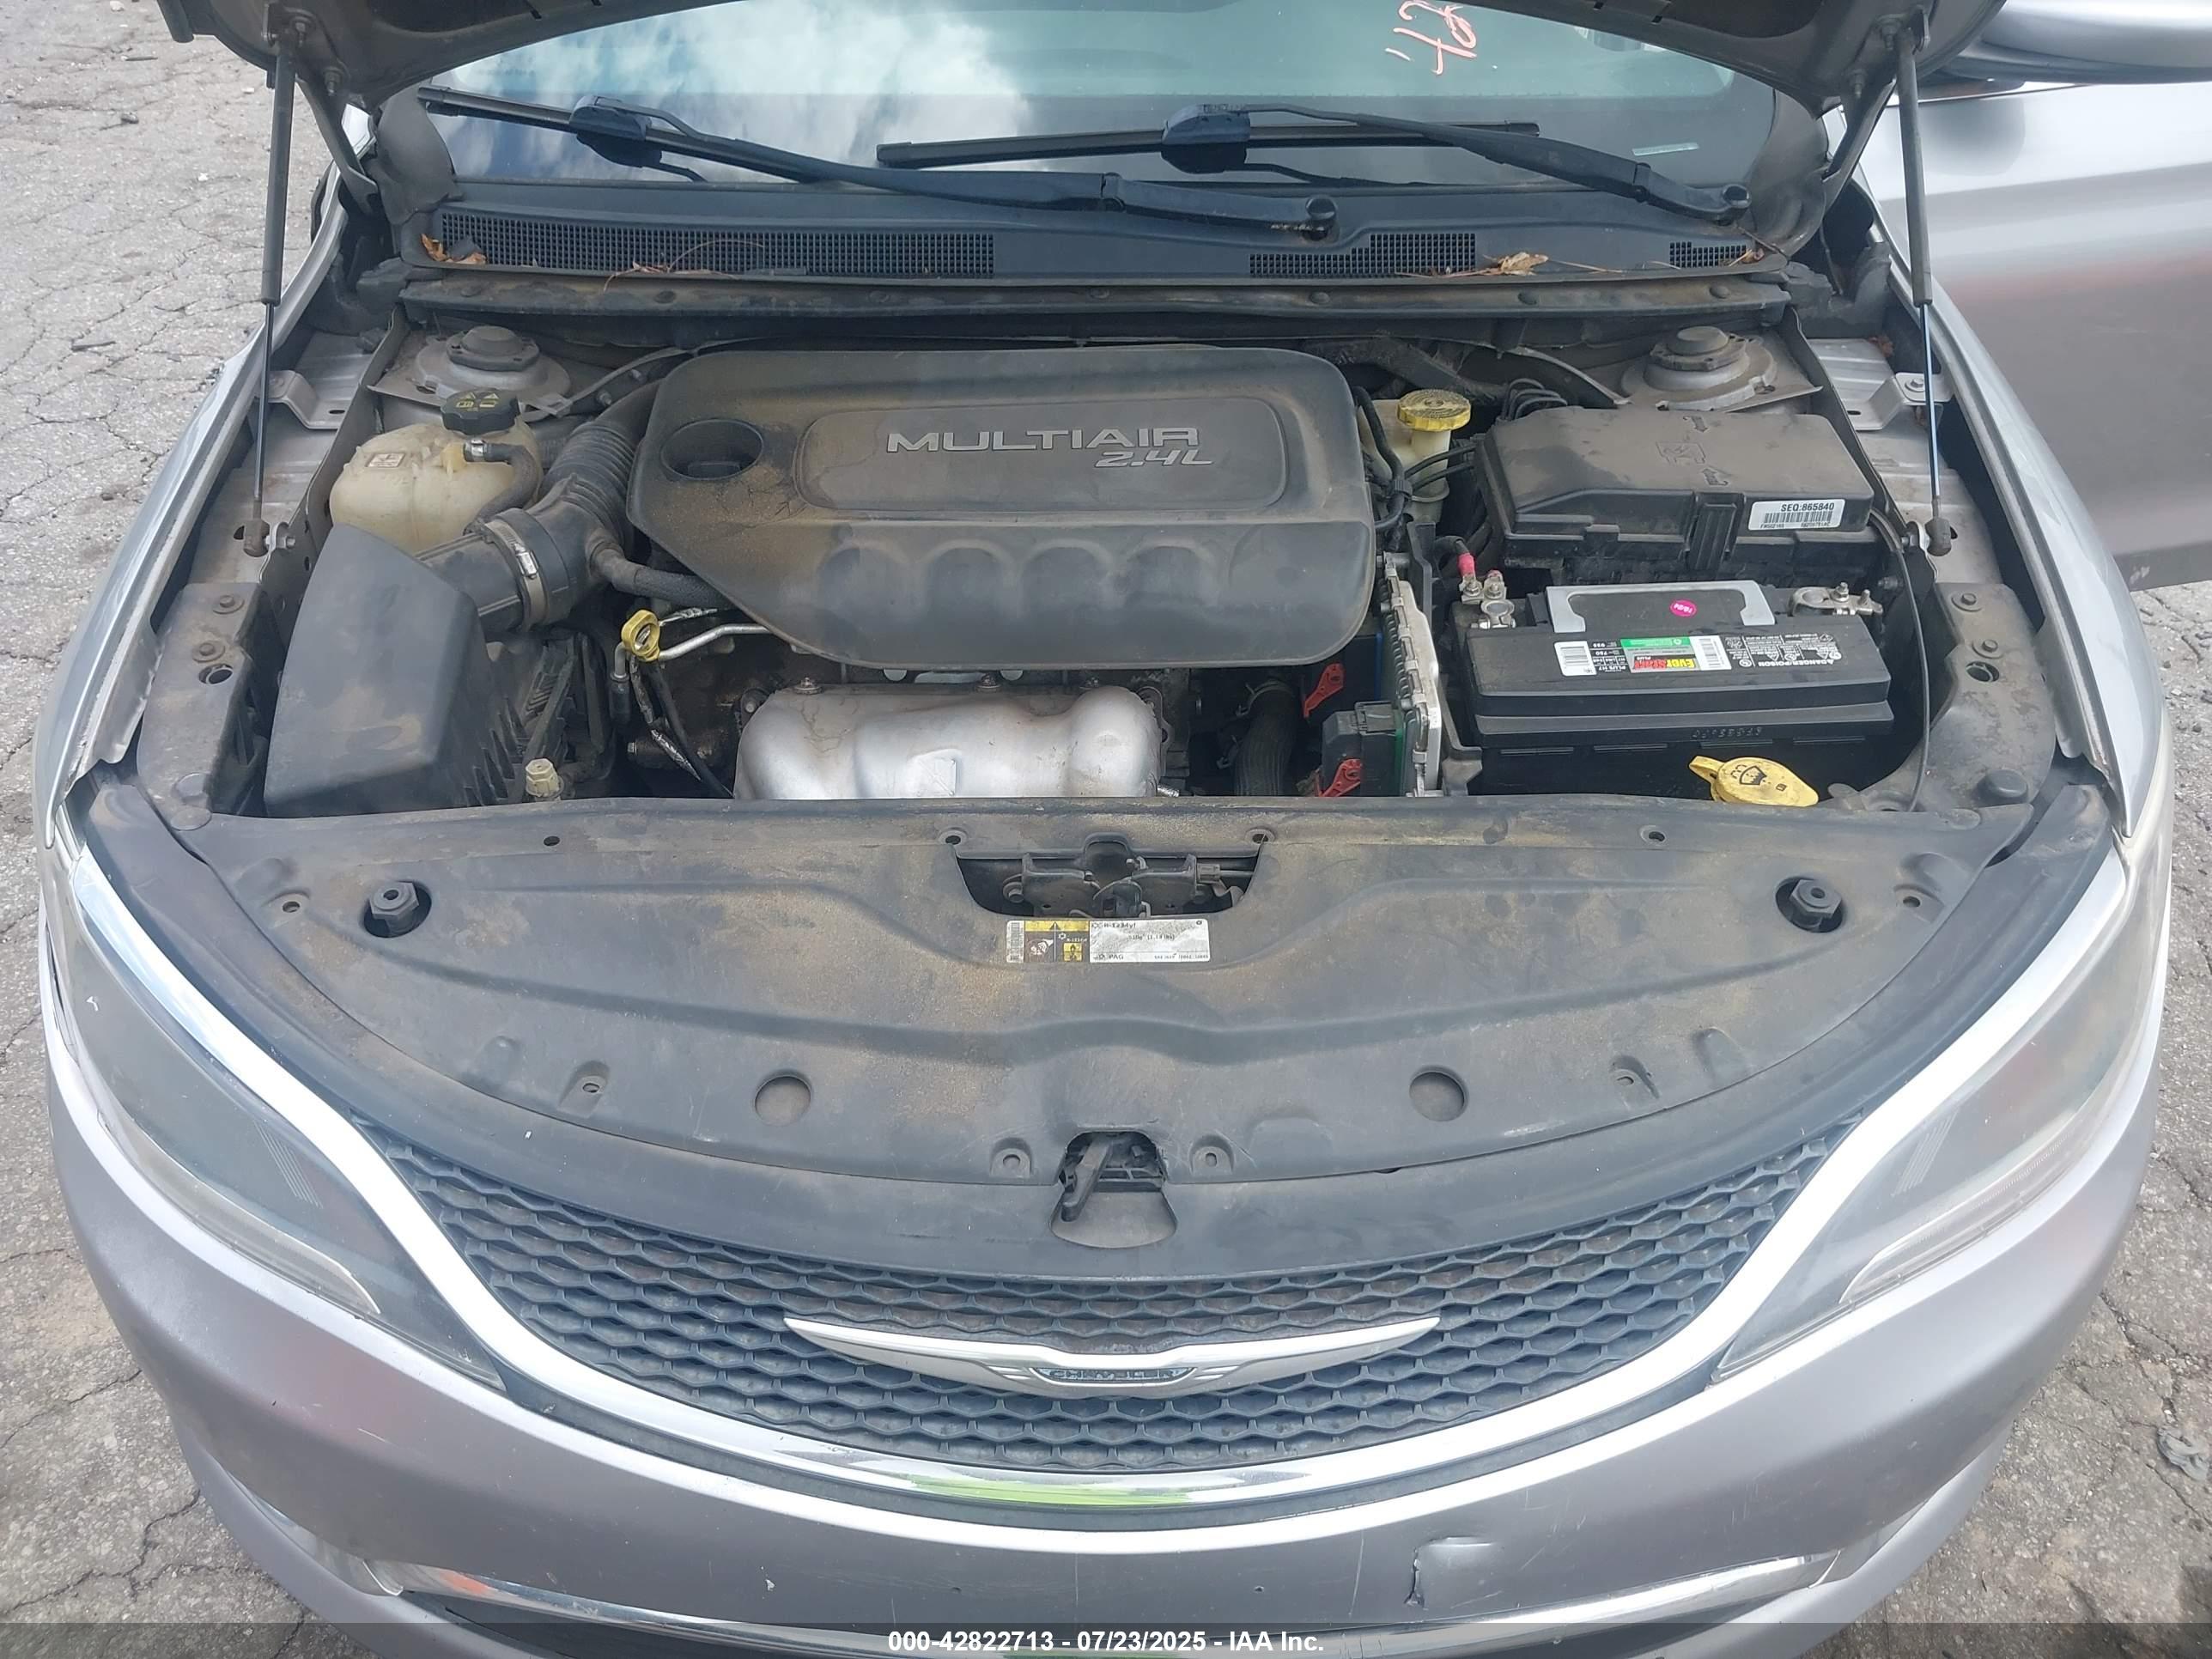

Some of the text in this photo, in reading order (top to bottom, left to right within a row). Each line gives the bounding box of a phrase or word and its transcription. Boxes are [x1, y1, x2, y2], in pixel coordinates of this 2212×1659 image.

[886, 427, 1200, 453] MULTIAIR
[1094, 449, 1214, 468] 2.4L
[1780, 502, 1835, 512] SEQ:865840
